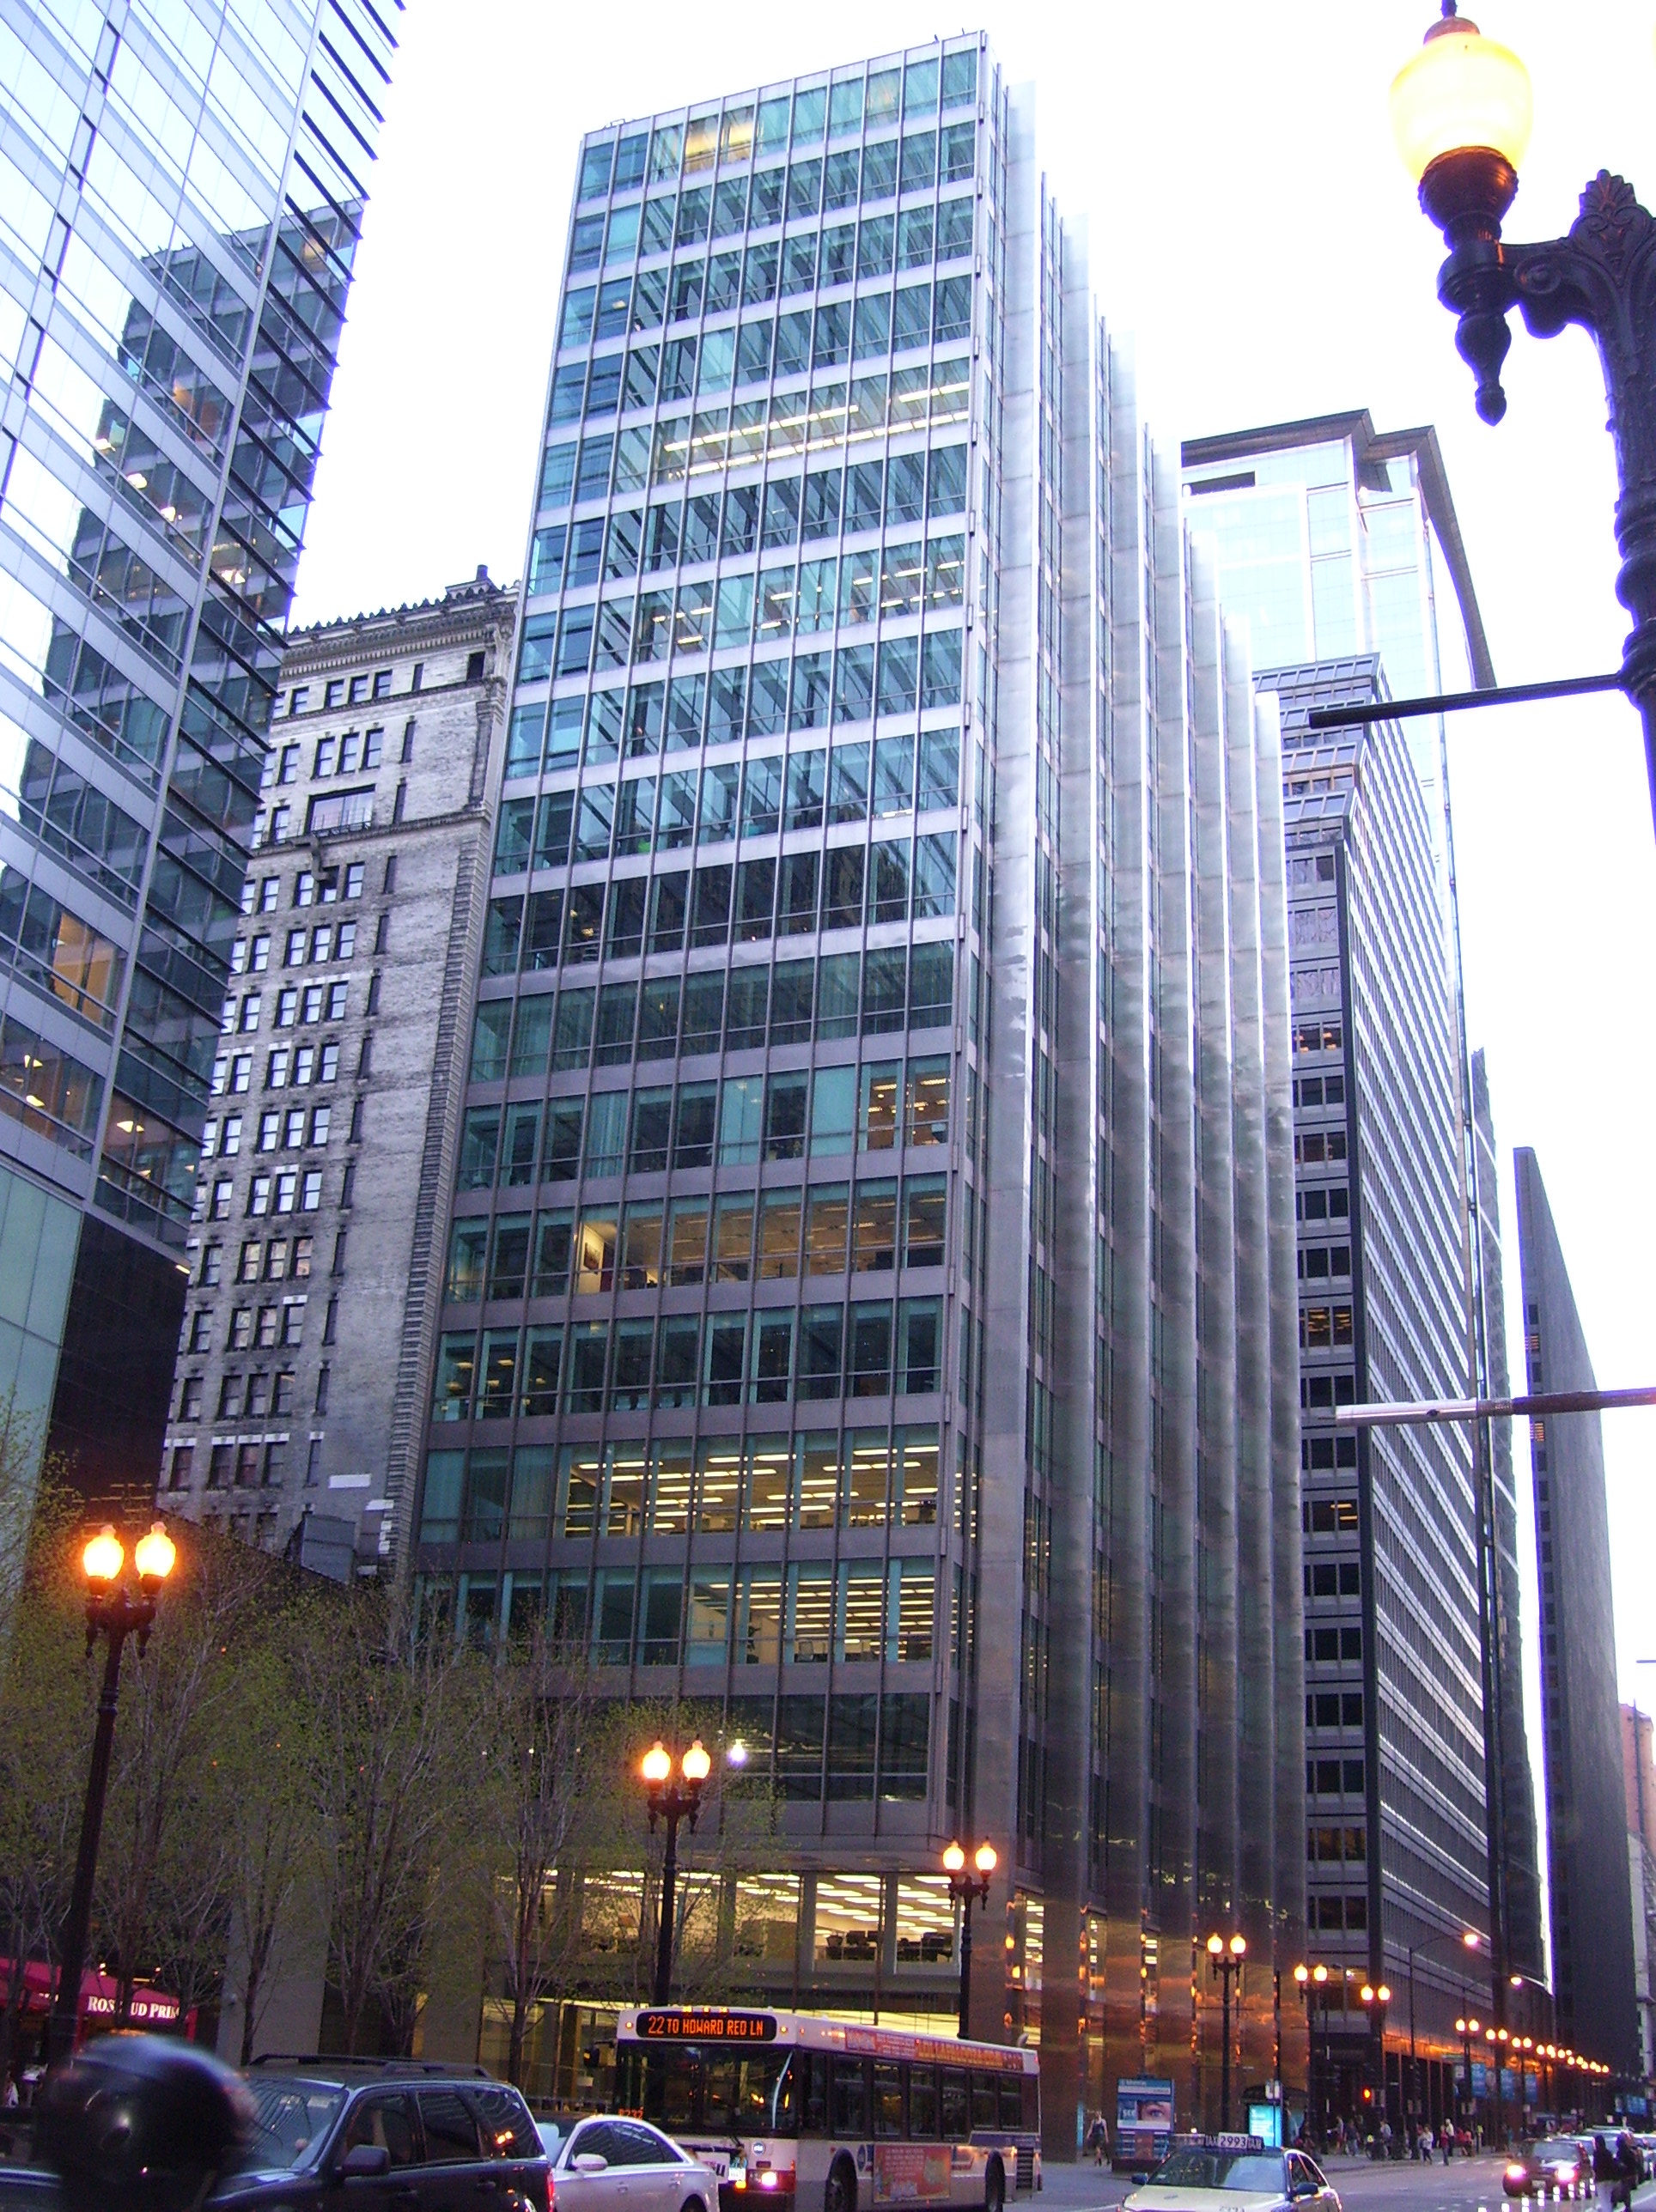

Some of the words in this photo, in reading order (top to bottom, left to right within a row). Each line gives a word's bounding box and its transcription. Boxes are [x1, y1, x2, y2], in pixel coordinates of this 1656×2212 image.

[87, 1996, 148, 2016] ROSUD
[648, 2015, 665, 2034] 22
[667, 2018, 679, 2034] TO
[682, 2019, 724, 2035] HOWARD
[727, 2020, 747, 2036] RED
[750, 2021, 764, 2037] LN
[1220, 2135, 1247, 2148] 2993
